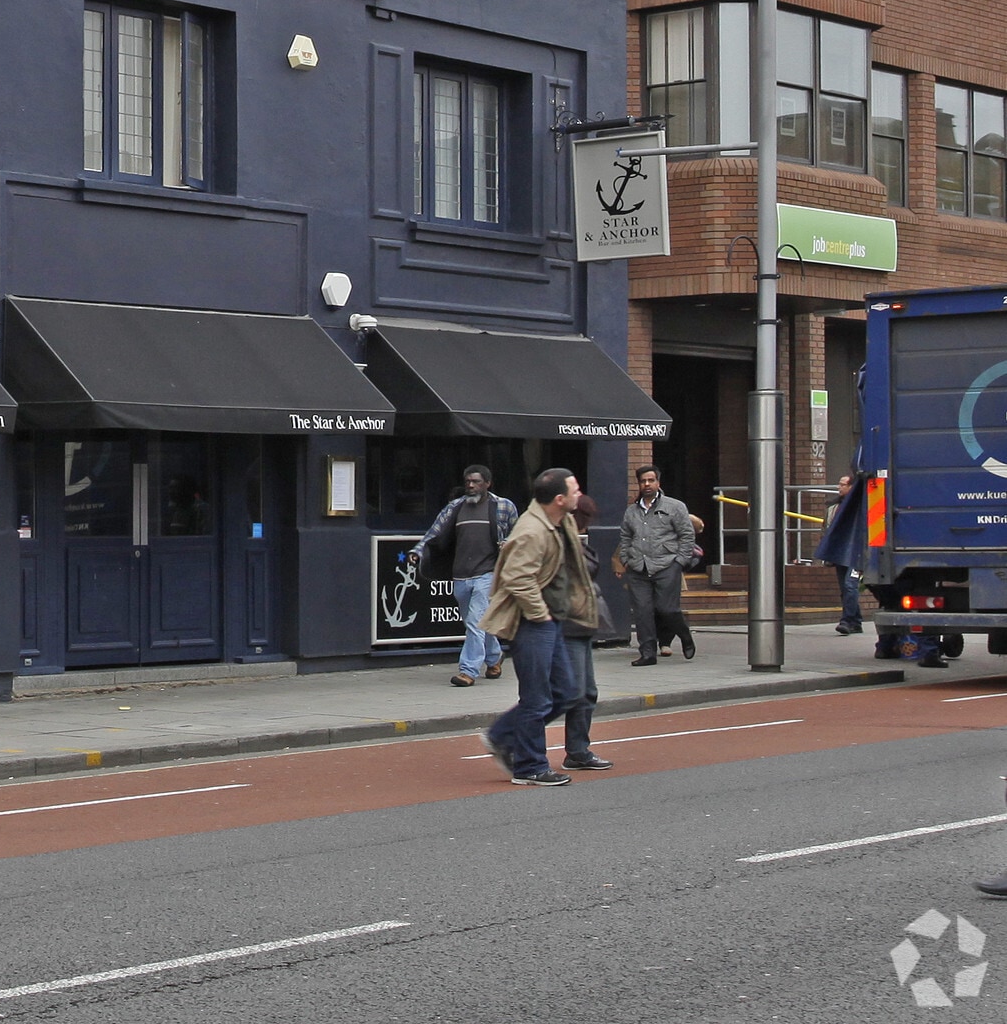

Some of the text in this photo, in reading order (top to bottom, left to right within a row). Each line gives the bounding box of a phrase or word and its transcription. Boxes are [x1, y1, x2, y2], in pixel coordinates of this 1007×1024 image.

[603, 217, 638, 228] STAR
[584, 226, 659, 241] & ANCHOR
[812, 236, 865, 259] jobcentreplus
[289, 414, 385, 430] The Star & Anchor
[558, 423, 667, 436] reservations 02085678487
[812, 441, 825, 457] 92
[430, 606, 463, 622] FRES
